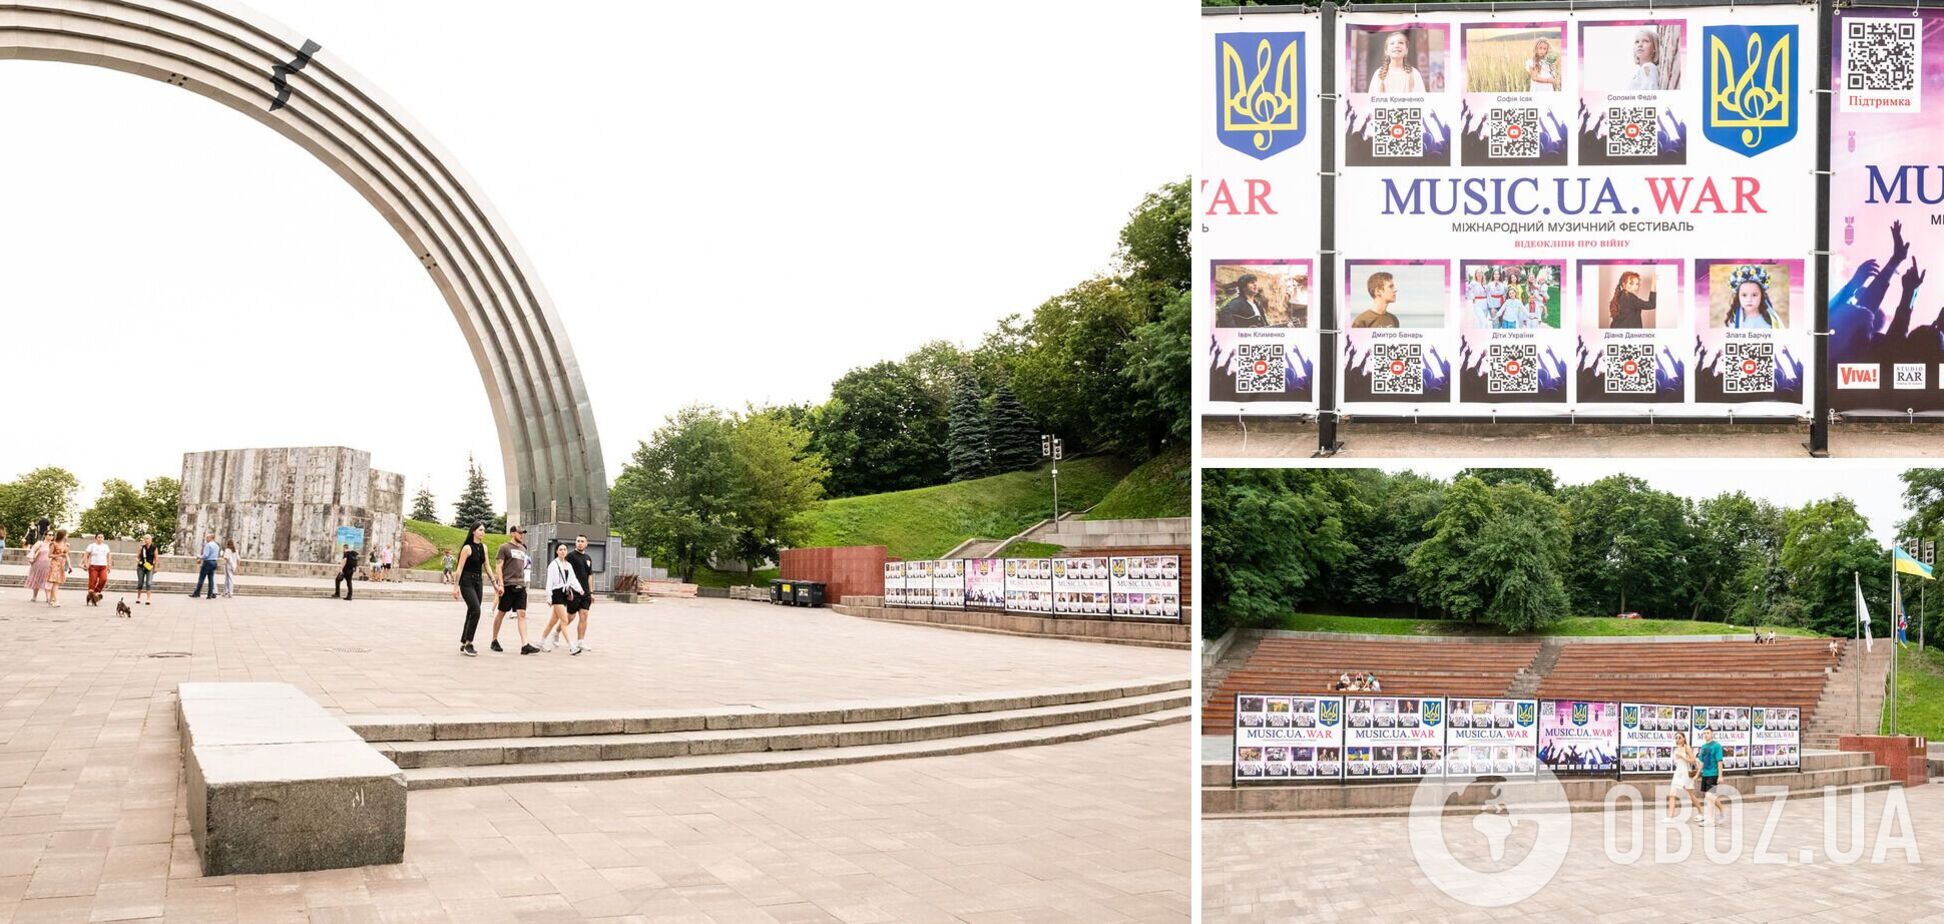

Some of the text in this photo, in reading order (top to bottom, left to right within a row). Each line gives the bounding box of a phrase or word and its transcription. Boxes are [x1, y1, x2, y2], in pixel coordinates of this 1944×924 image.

[1497, 95, 1517, 103] Софія
[1849, 95, 1911, 108] Підтримка
[1201, 179, 1278, 215] AR
[1452, 220, 1694, 234] МІЖНАРОДНИЙ МУЗИЧНИЙ ФЕСТИВАЛЬ
[1514, 238, 1631, 248] ВІДЕОКЛІПИ ПРО ВІЙНУ
[1371, 331, 1397, 339] Дмитро
[1508, 331, 1534, 339] України
[1748, 332, 1771, 340] Барчук
[1897, 372, 1923, 382] RAR
